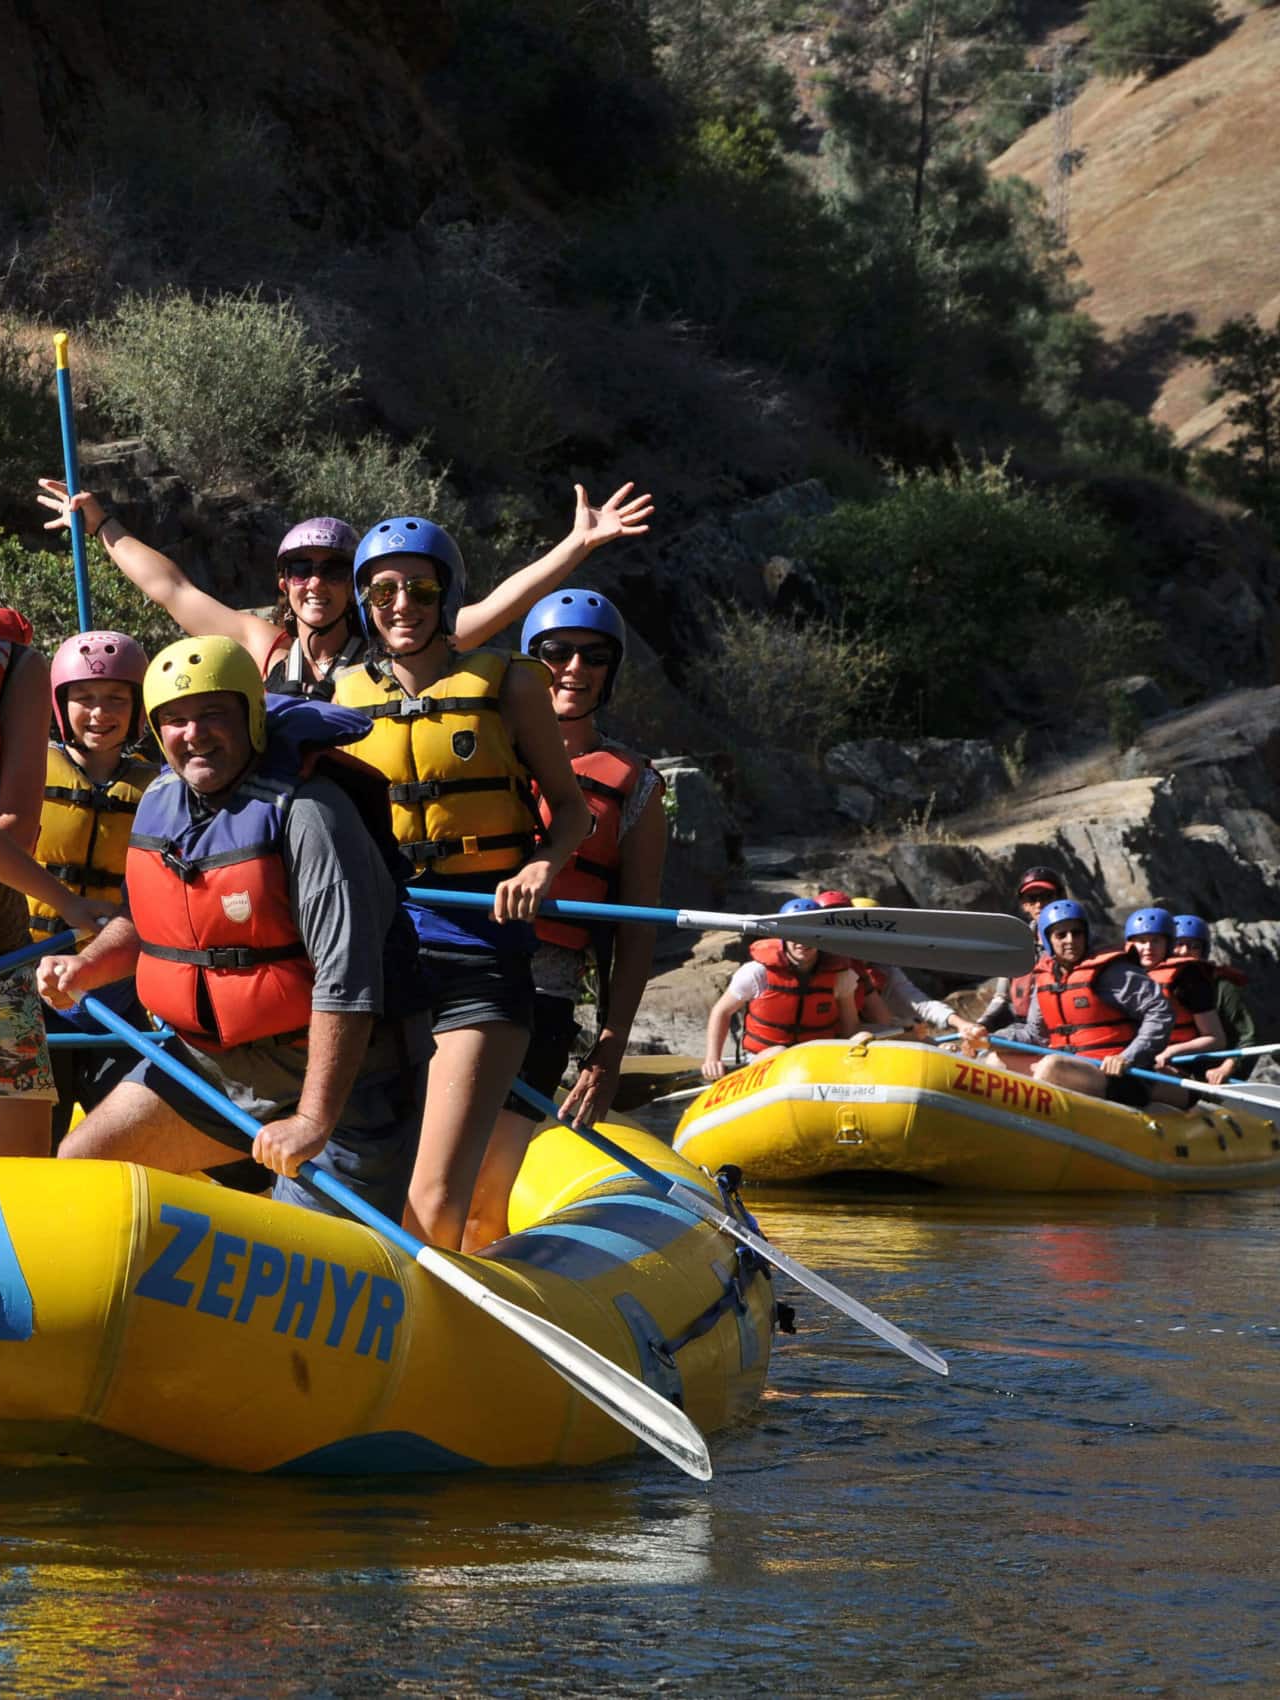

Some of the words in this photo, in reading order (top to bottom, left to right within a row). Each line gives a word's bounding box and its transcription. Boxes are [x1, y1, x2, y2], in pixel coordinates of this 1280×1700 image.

[704, 1058, 776, 1109] ZEPHYR
[953, 1064, 1053, 1115] ZEPHYR
[134, 1204, 405, 1363] ZEPHYR
